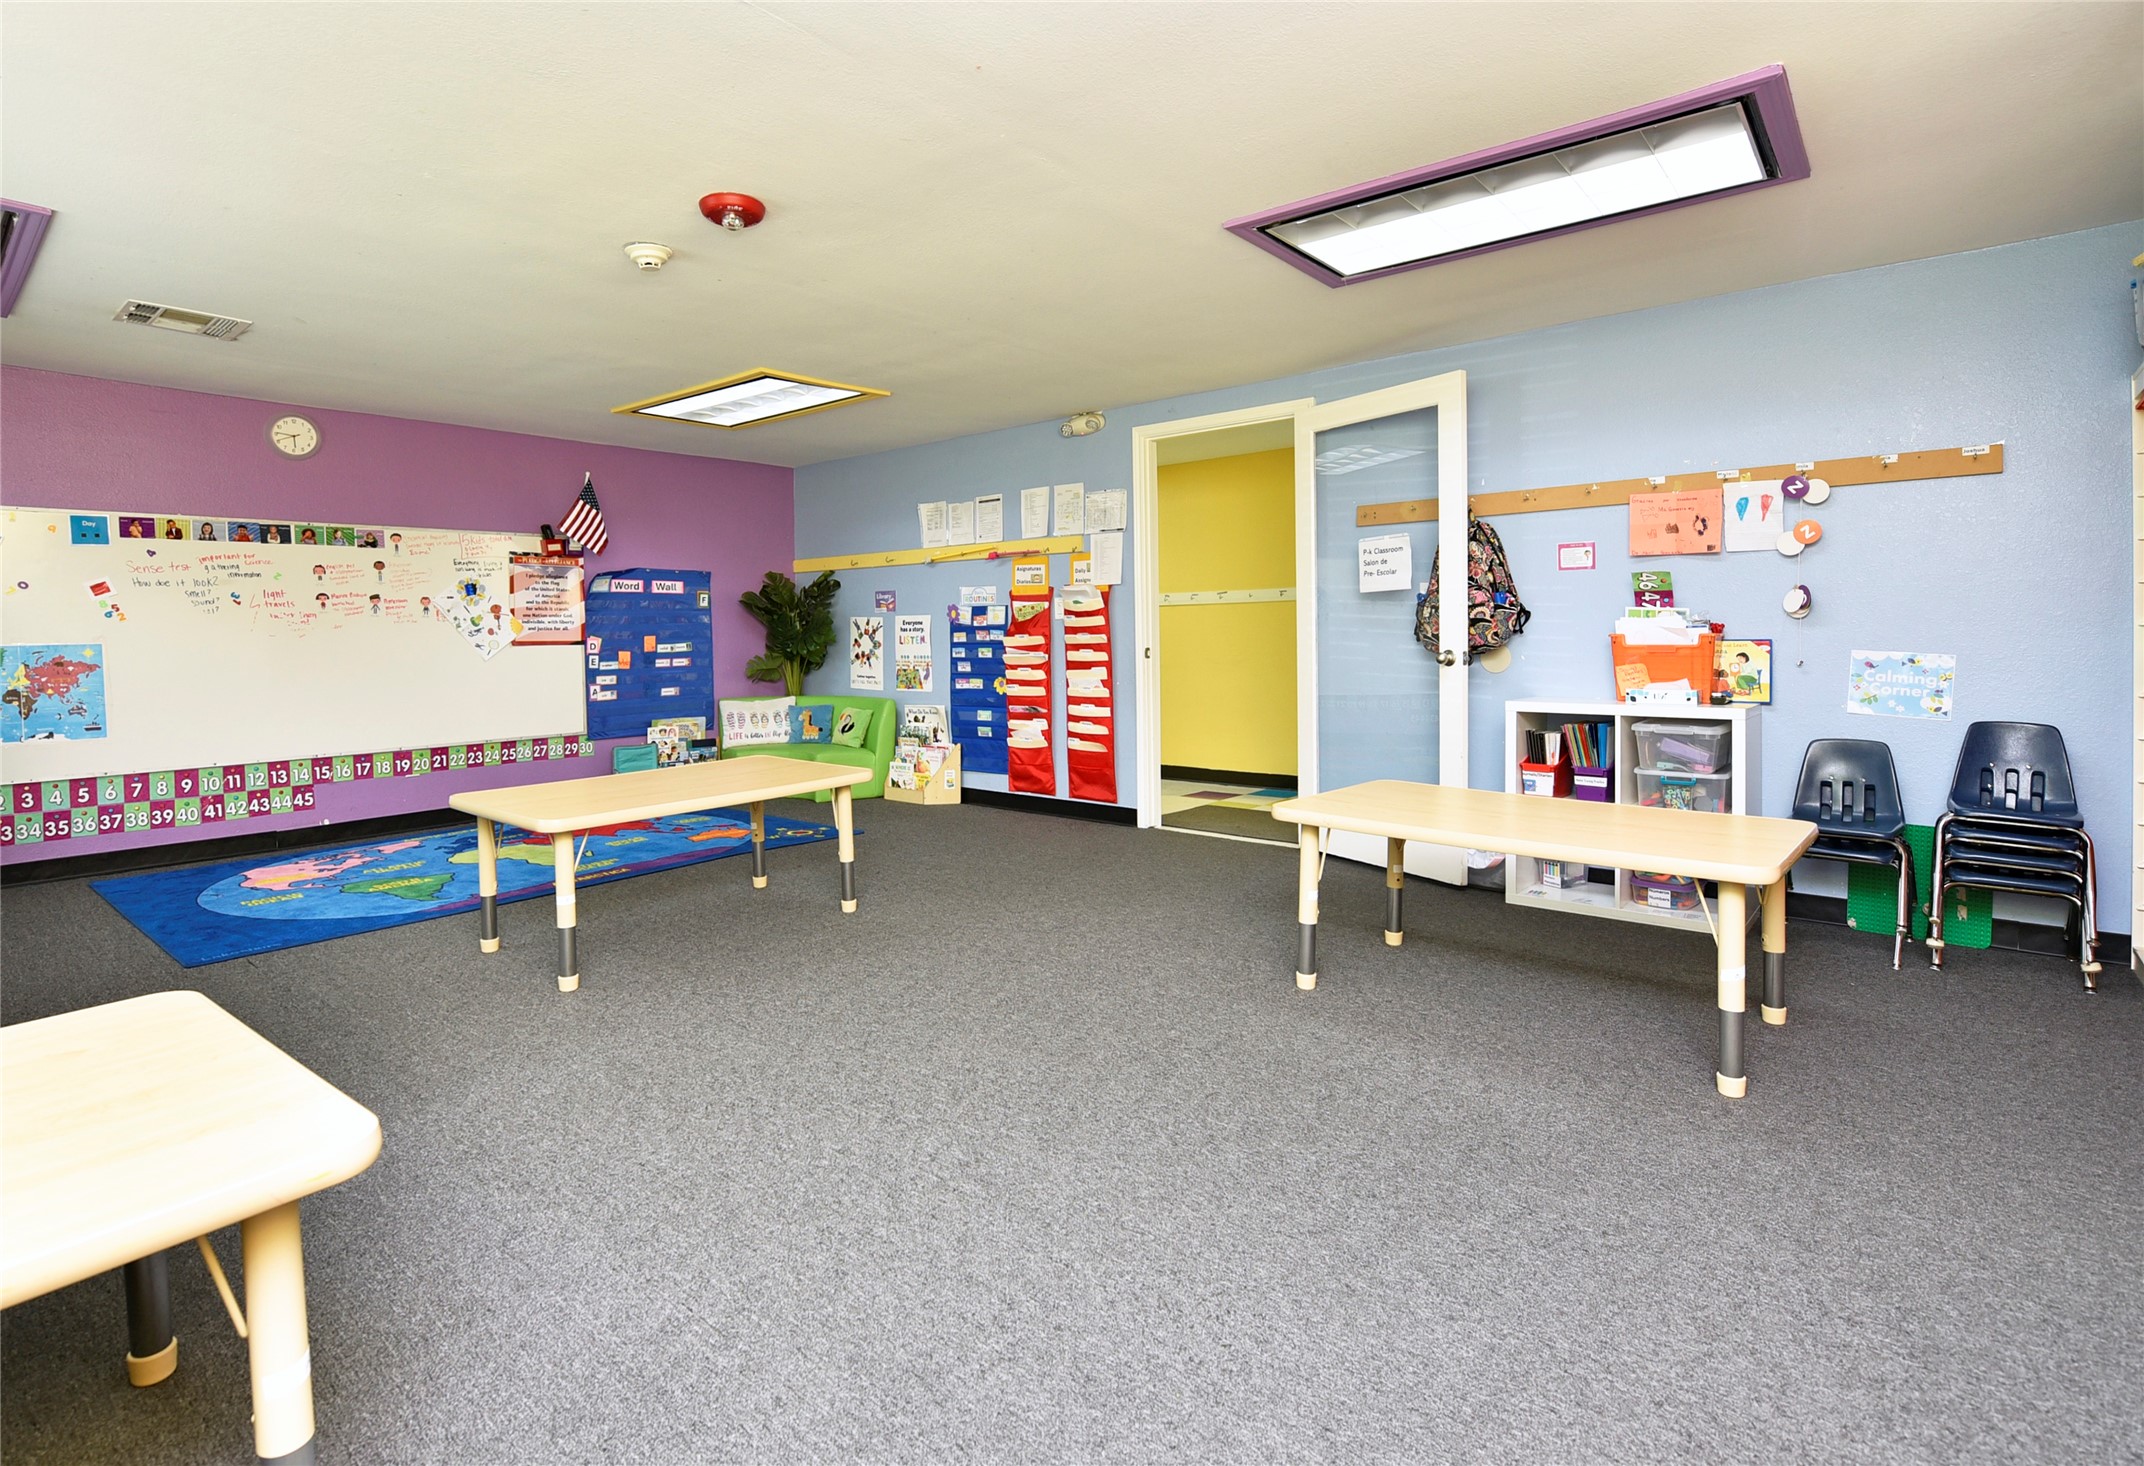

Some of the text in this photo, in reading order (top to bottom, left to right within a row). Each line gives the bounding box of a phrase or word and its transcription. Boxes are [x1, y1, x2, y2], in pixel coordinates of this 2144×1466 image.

[1374, 546, 1404, 555] Classroom
[126, 560, 191, 573] Sense test
[1376, 568, 1397, 576] Escolar
[132, 578, 151, 587] How
[614, 581, 677, 592] Word Wall
[1638, 572, 1658, 590] 46
[263, 589, 287, 600] light
[702, 596, 706, 604] F
[111, 604, 120, 612] 5
[117, 612, 126, 621] 2
[1864, 669, 1937, 688] Calming
[1870, 682, 1930, 697] Corner
[729, 732, 743, 740] LIFE
[21, 793, 34, 808] 3
[50, 790, 63, 806] 4
[77, 788, 90, 803] 5
[105, 785, 117, 800] 6
[131, 783, 143, 798] 7
[156, 781, 168, 796] 8
[181, 779, 192, 793] 9
[202, 777, 220, 791] 10
[227, 775, 241, 789] 11
[248, 773, 265, 787] 12
[270, 770, 288, 784] 13
[293, 768, 309, 782] 14
[314, 766, 330, 779] 15
[336, 765, 351, 778] 16
[356, 763, 371, 776] 17
[376, 761, 391, 774] 18
[395, 760, 410, 772] 19
[413, 758, 430, 771] 20
[433, 755, 447, 768] 21
[450, 754, 466, 766] 22
[467, 752, 483, 764] 23
[485, 750, 499, 762] 24
[502, 748, 516, 760] 25
[518, 747, 531, 759] 26
[533, 745, 547, 757] 27
[549, 744, 563, 755] 28
[565, 743, 578, 754] 29
[580, 742, 593, 753] 30
[0, 793, 314, 842] 3 34 35 36 37 38 39 40 41 42 43 44 45
